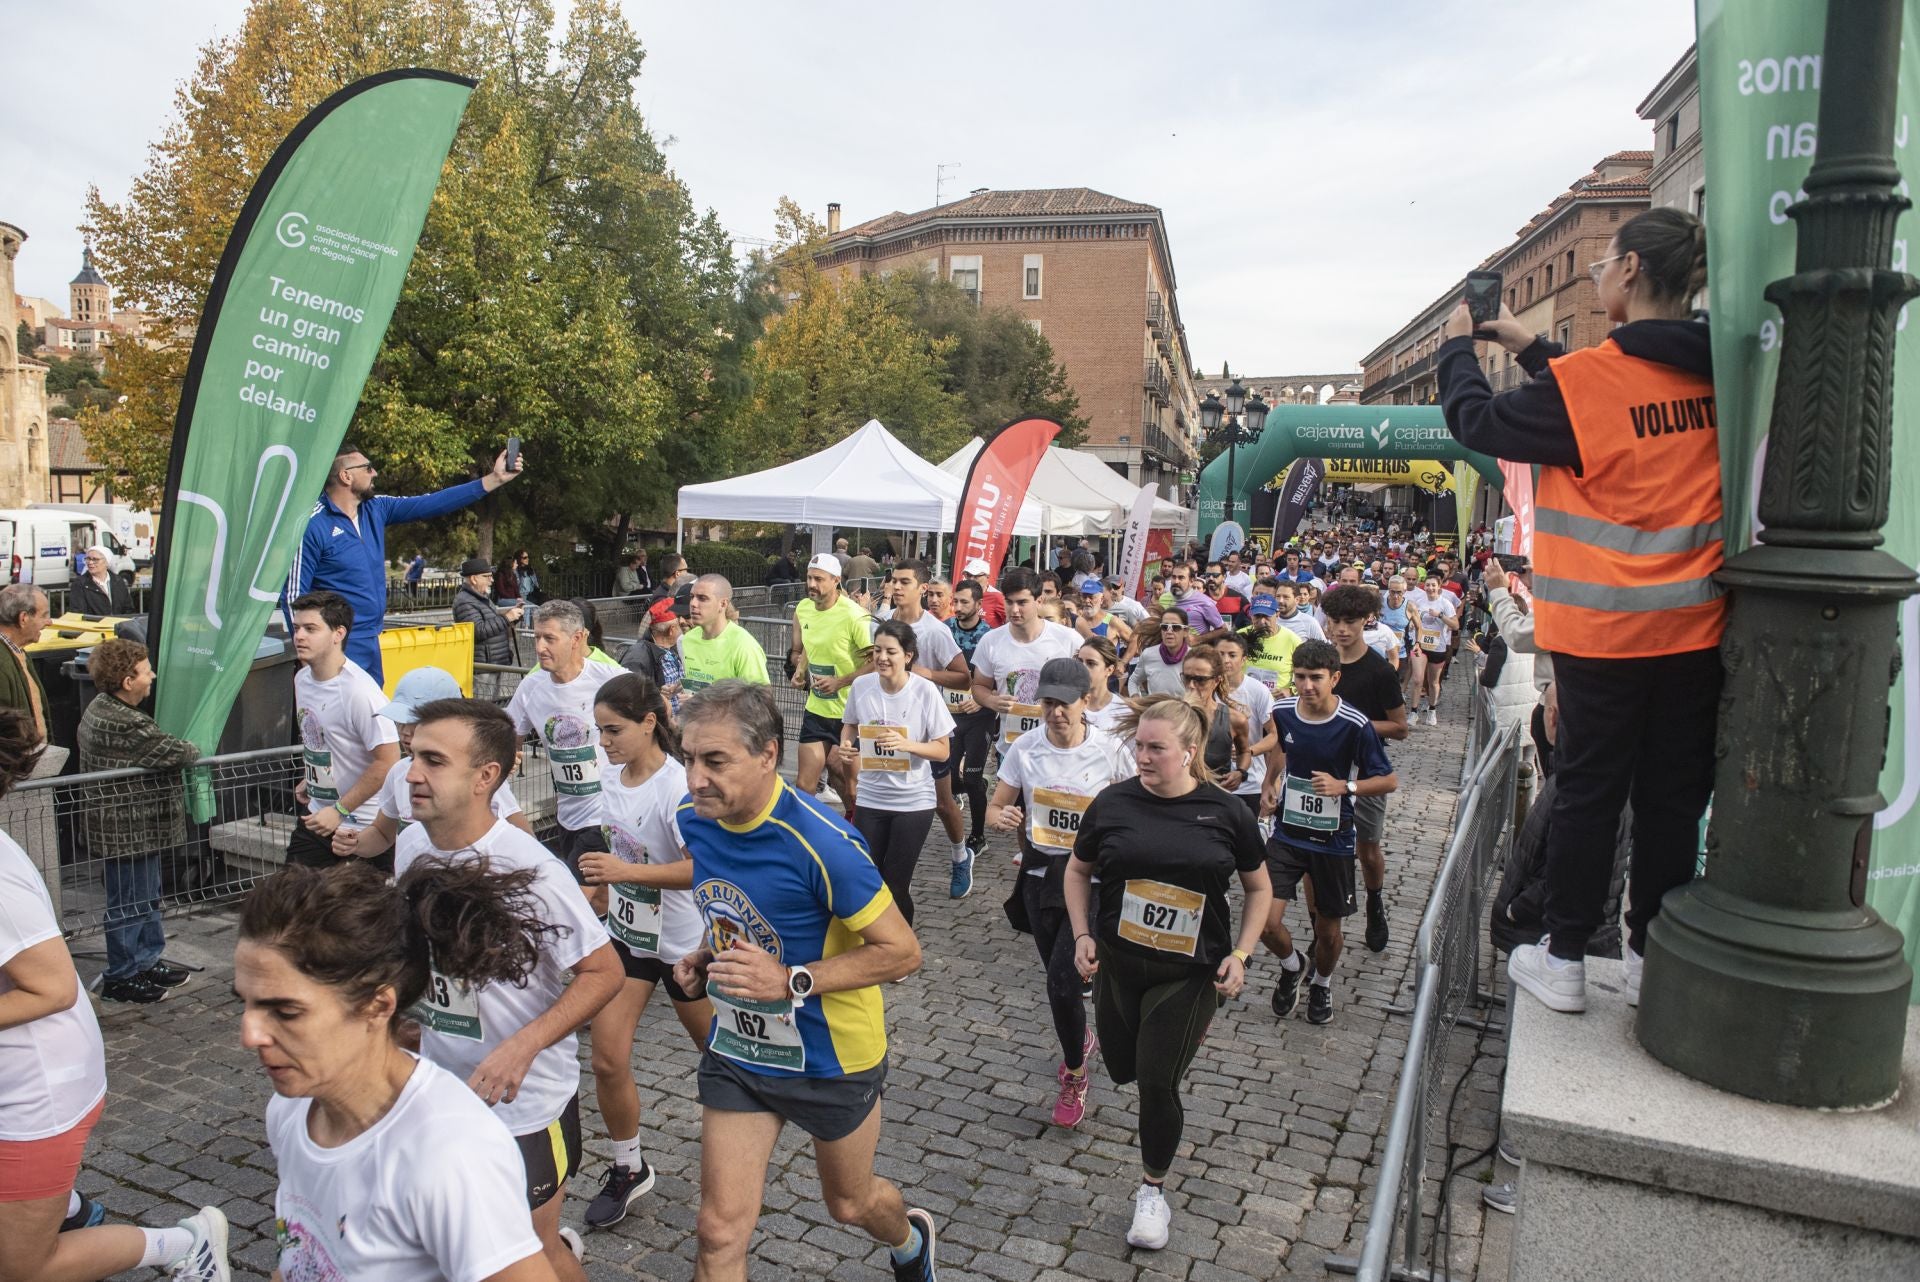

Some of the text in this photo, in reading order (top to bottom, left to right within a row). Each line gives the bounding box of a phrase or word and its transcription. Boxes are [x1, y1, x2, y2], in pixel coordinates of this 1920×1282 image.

[309, 245, 355, 264] en Segovia
[313, 233, 378, 260] contra el cáncer
[316, 224, 399, 257] asociación española
[270, 276, 365, 324] Tenemos
[259, 306, 341, 345] un gran
[252, 333, 330, 369] camino
[244, 359, 284, 382] por
[239, 384, 317, 423] delante
[1296, 423, 1366, 441] cajaviva
[1395, 442, 1445, 450] Fundación
[1124, 520, 1139, 575] PINAR
[562, 764, 583, 781] 173
[1300, 794, 1323, 814] 158
[1049, 809, 1080, 831] 658
[618, 896, 635, 925] 26
[1143, 902, 1179, 931] 627
[731, 1008, 770, 1040] 162
